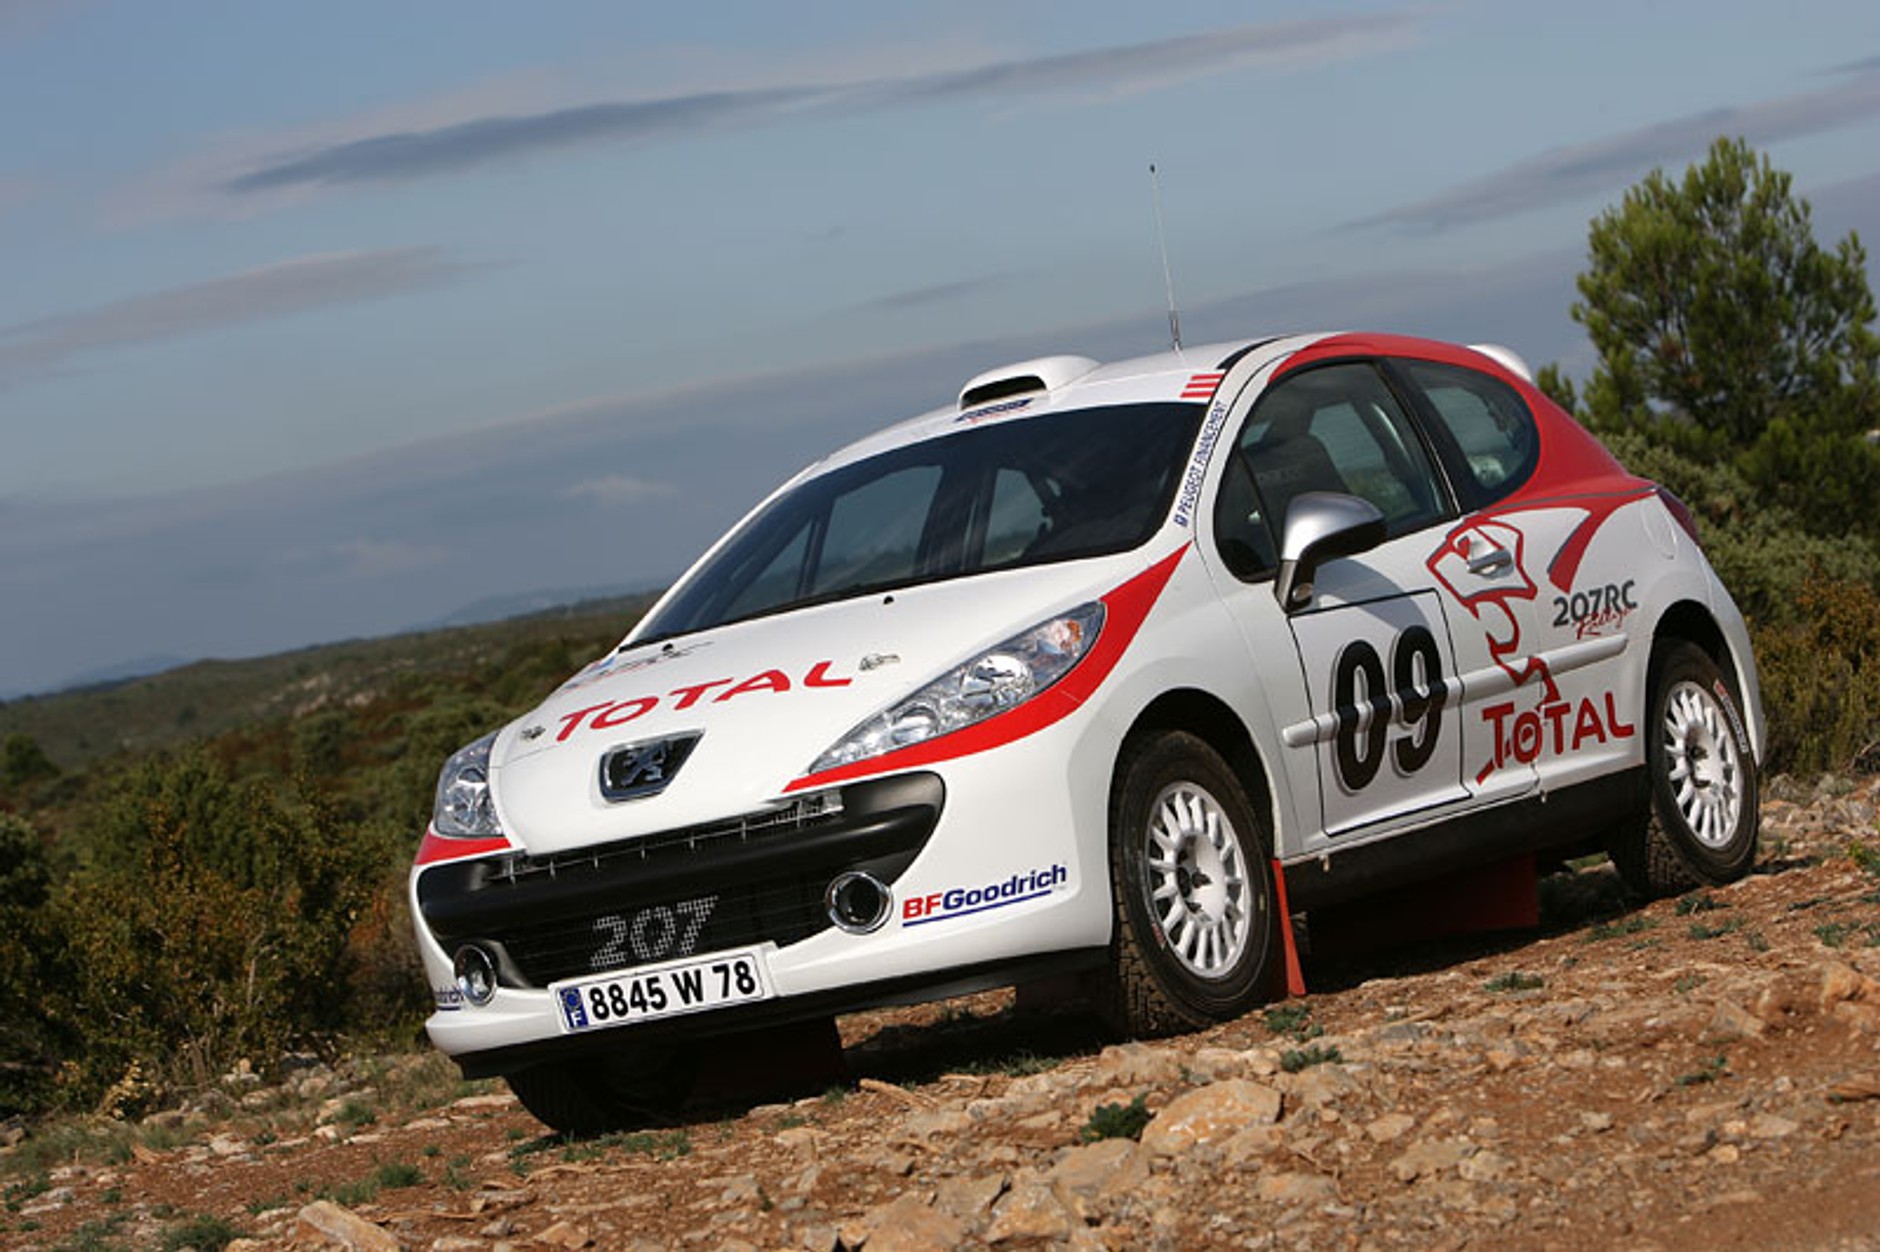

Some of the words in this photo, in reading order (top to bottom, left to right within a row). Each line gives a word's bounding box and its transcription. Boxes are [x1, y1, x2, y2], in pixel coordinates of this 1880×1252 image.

[1177, 465, 1202, 516] PEUGEOT
[1193, 400, 1228, 467] FINANCEMENT
[555, 660, 853, 742] TOTAL
[1333, 624, 1447, 793] 09
[1480, 691, 1635, 770] TOTAL
[902, 864, 1067, 920] BFGoodrich
[588, 895, 719, 969] 207
[589, 976, 667, 1021] 8845
[670, 968, 704, 1005] W
[712, 960, 756, 999] 78
